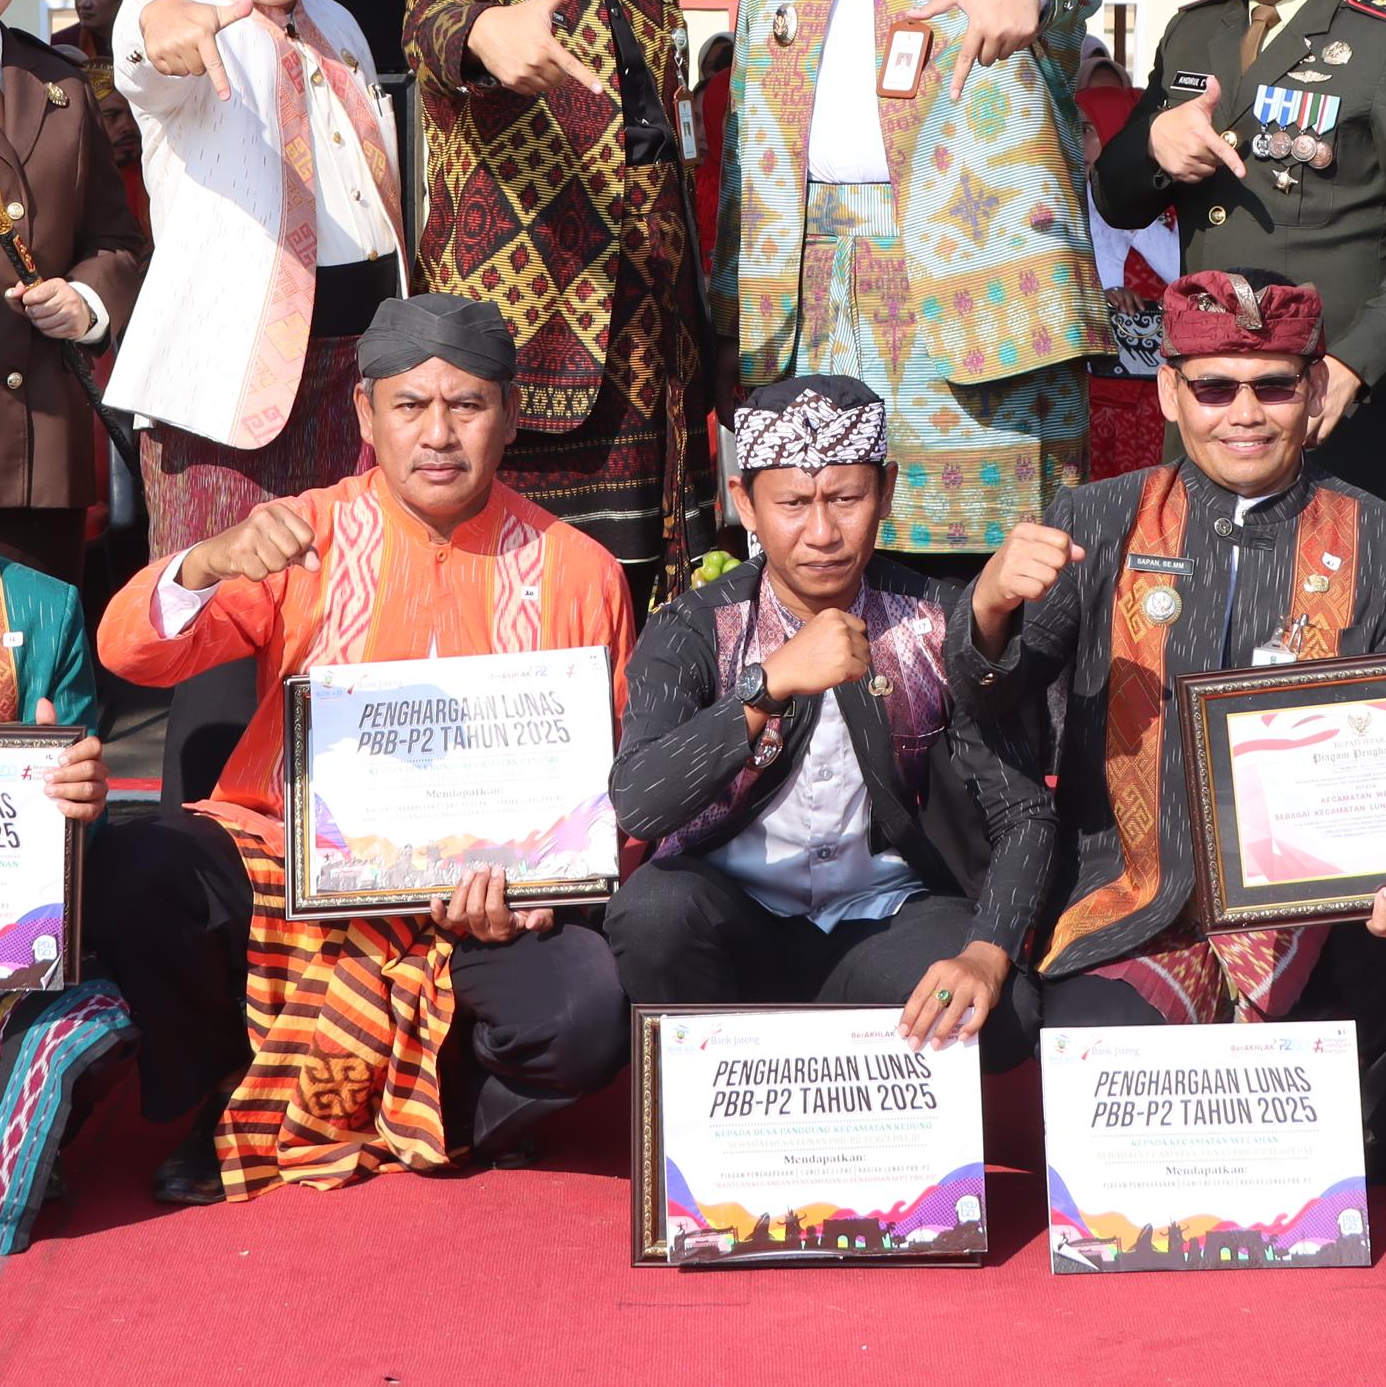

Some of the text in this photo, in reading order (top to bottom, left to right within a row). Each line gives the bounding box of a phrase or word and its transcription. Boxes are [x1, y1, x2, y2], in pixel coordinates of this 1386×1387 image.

[358, 691, 566, 729] PENGHARGAAN LUNAS
[357, 719, 571, 756] PBB-P2 TAHUN 2025
[1275, 810, 1311, 821] SEBAGAI
[1314, 805, 1366, 817] KECAMATAN
[1321, 792, 1373, 804] KECAMATAN
[712, 1052, 933, 1088] PENGHARGAAN LUNAS
[1093, 1065, 1313, 1099] PENGHARGAAN LUNAS
[709, 1082, 938, 1119] PBB-P2 TAHUN 2025
[1091, 1095, 1319, 1129] PBB-P2 TAHUN 2025
